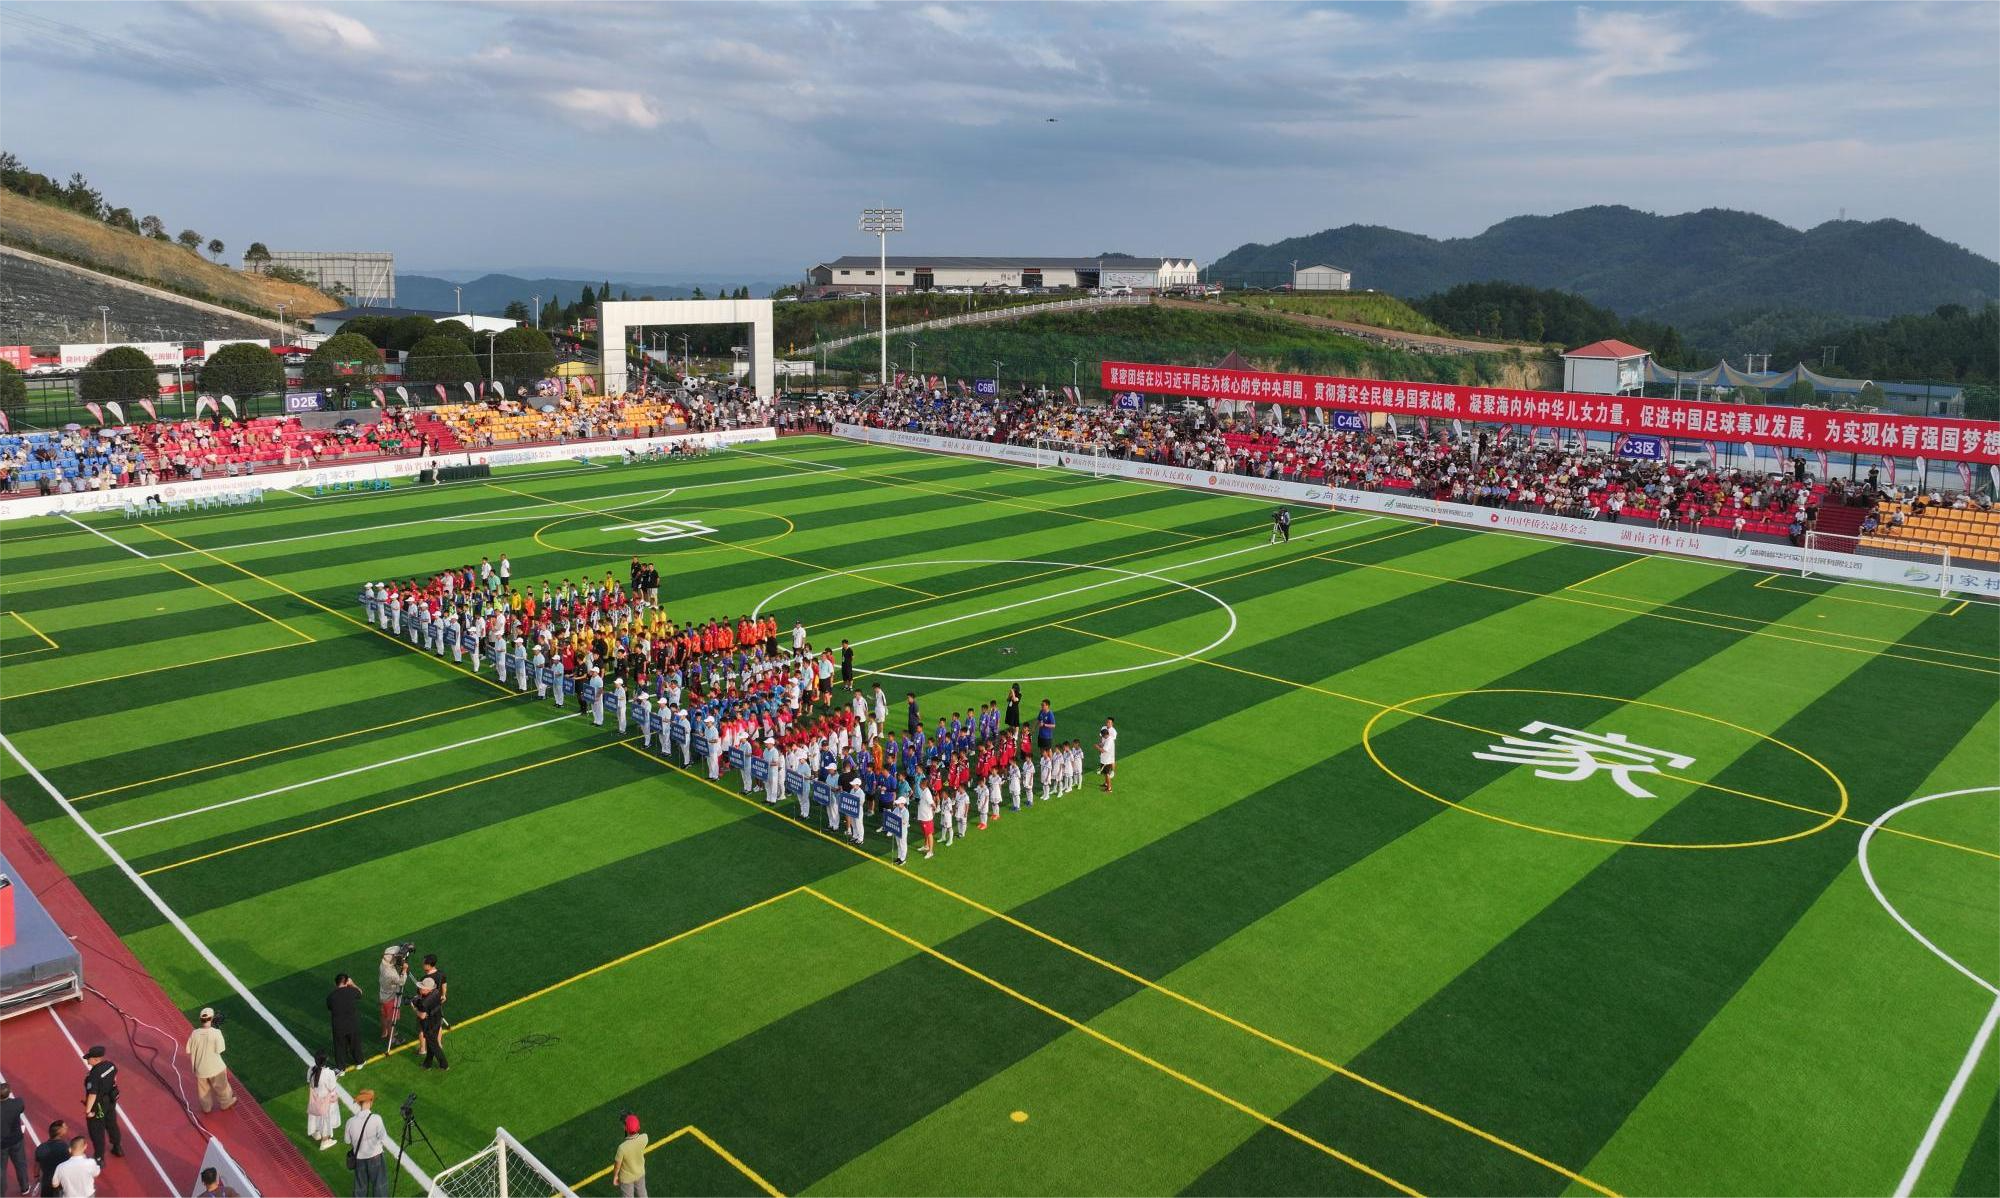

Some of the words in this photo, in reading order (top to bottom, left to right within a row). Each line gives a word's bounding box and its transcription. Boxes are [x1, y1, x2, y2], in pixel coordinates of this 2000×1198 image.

[291, 396, 318, 408] D2区
[1337, 415, 1361, 428] C4区
[1623, 441, 1655, 455] C3区
[1504, 514, 1588, 535] 中国华侨公益基金会
[1620, 529, 1701, 550] 湖南省体育局
[1472, 720, 1696, 798] 家
